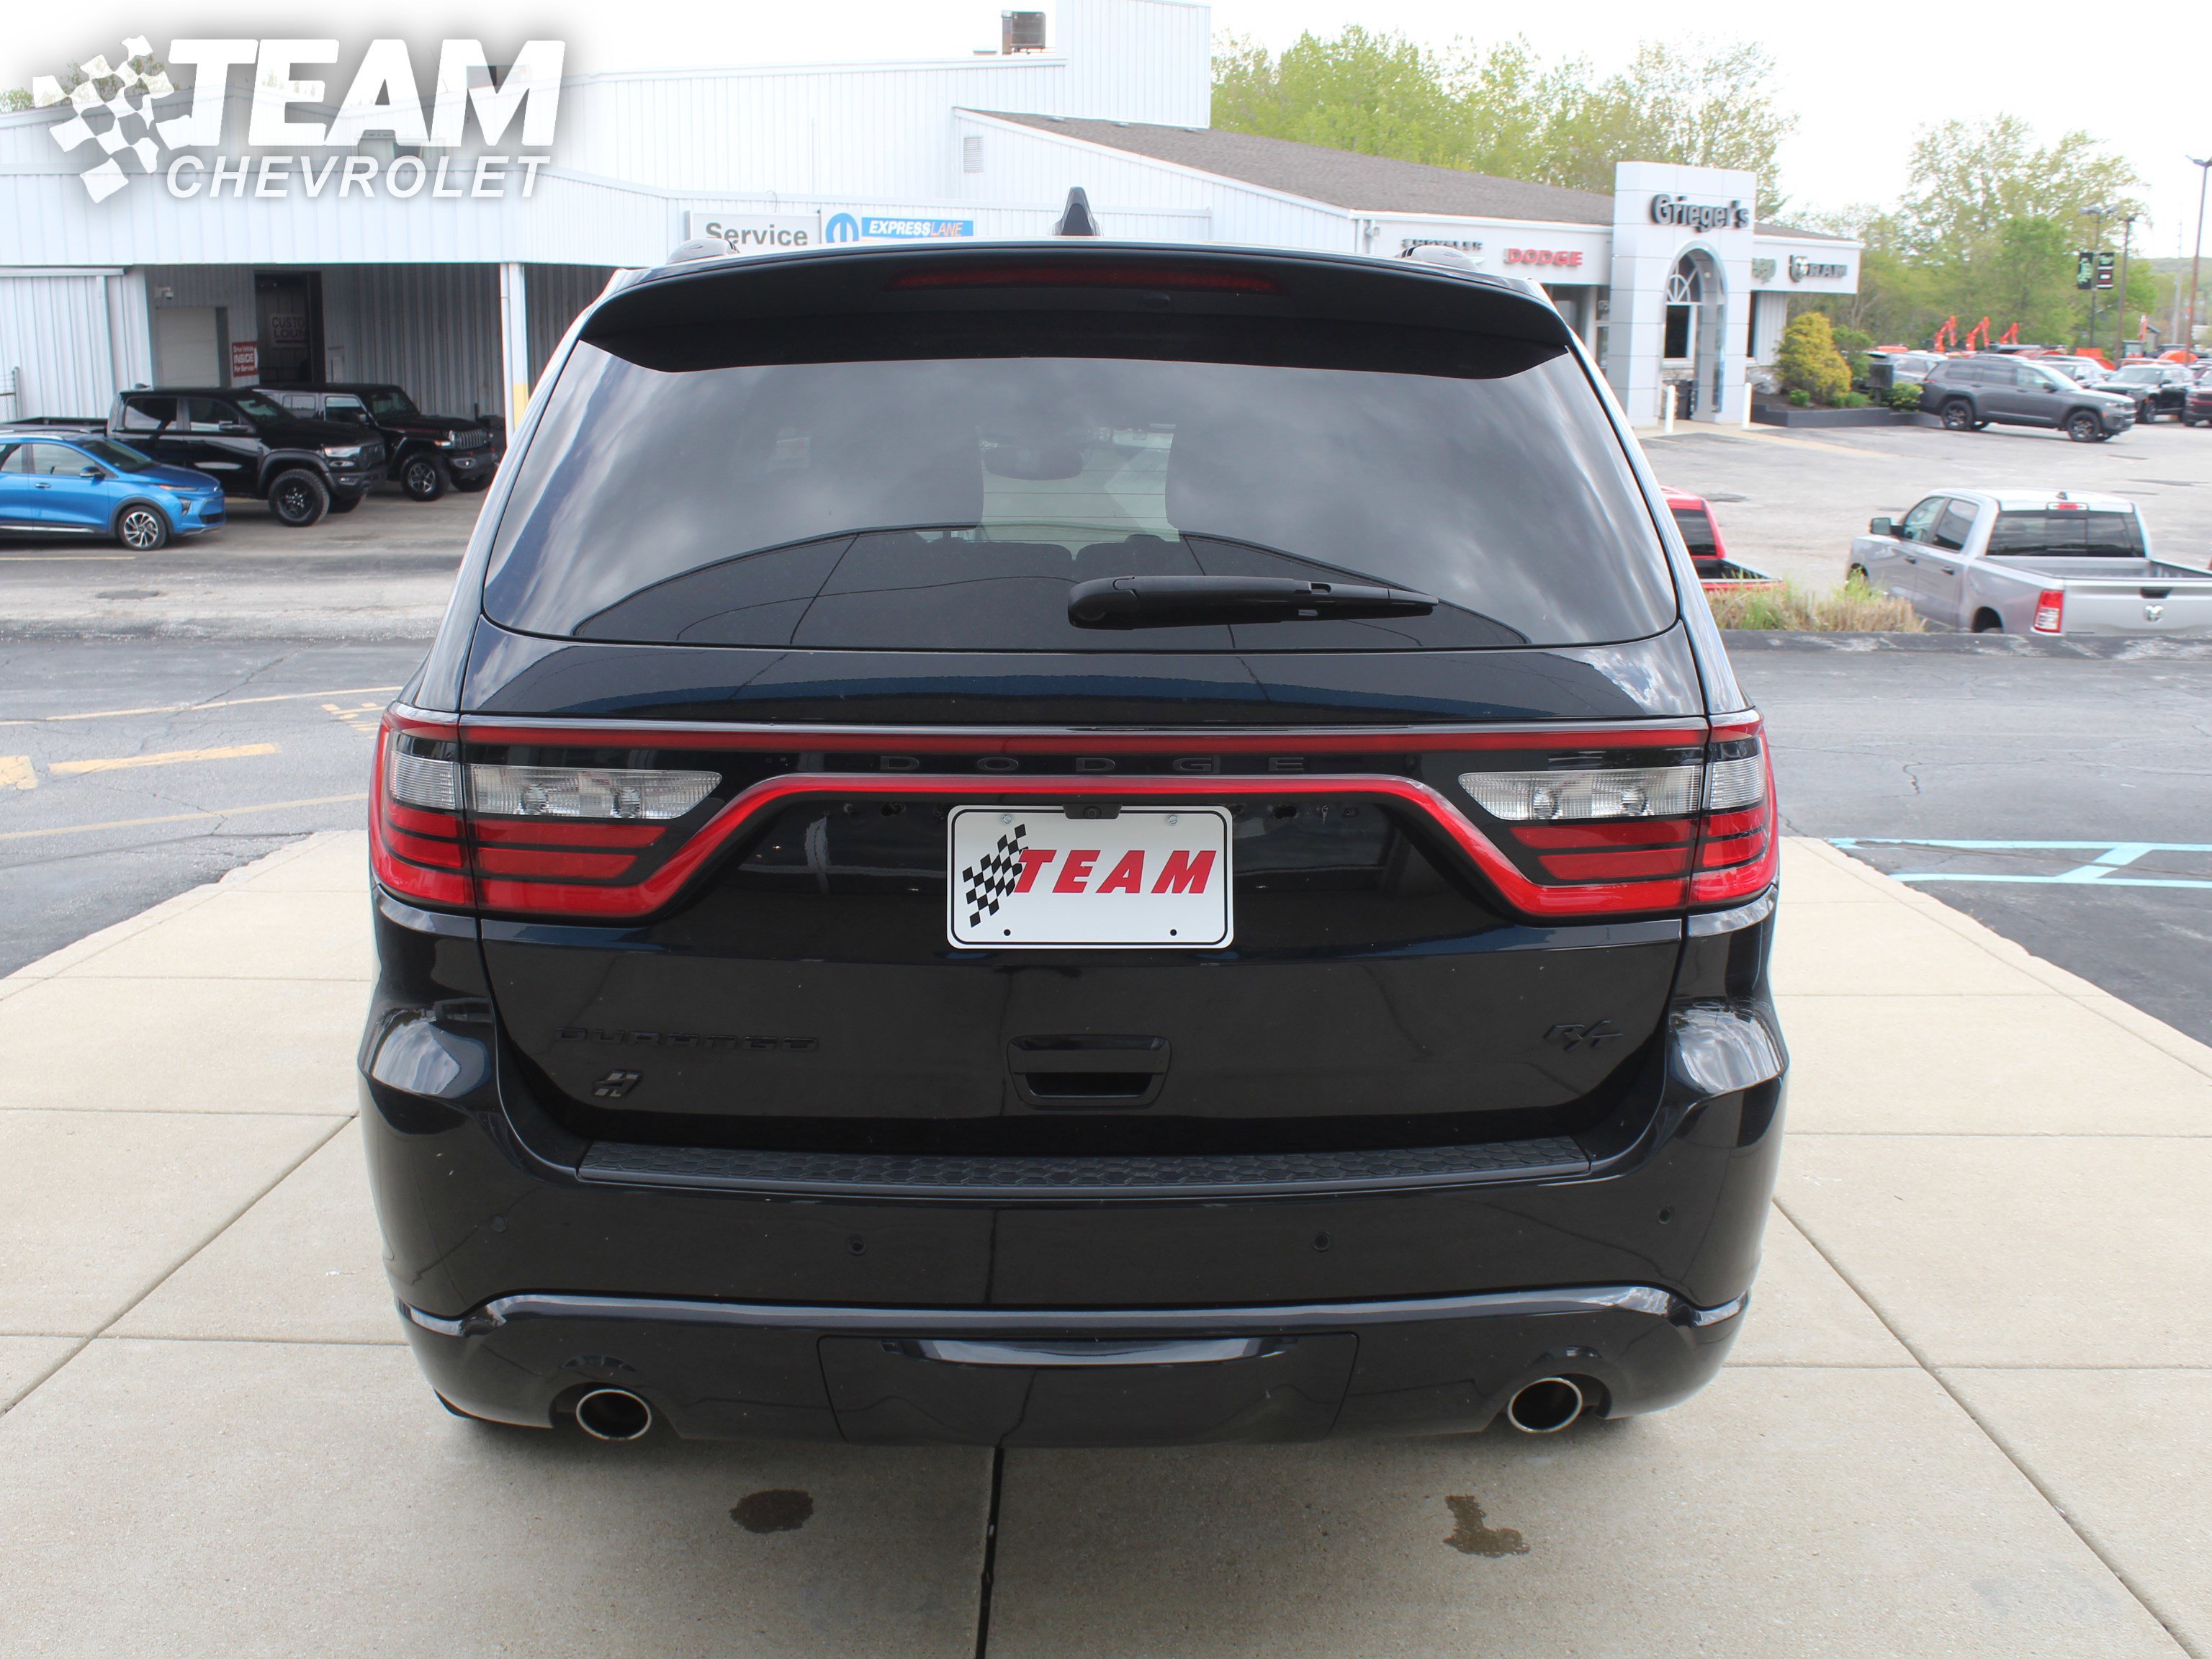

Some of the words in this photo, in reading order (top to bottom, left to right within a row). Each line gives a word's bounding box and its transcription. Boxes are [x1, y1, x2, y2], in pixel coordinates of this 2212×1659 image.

[1650, 194, 1750, 233] Grieger's
[706, 222, 808, 246] Service
[1504, 248, 1583, 266] DODGE
[881, 756, 1304, 773] DODGE
[1014, 850, 1216, 894] TEAM
[553, 1027, 819, 1051] DURANGO
